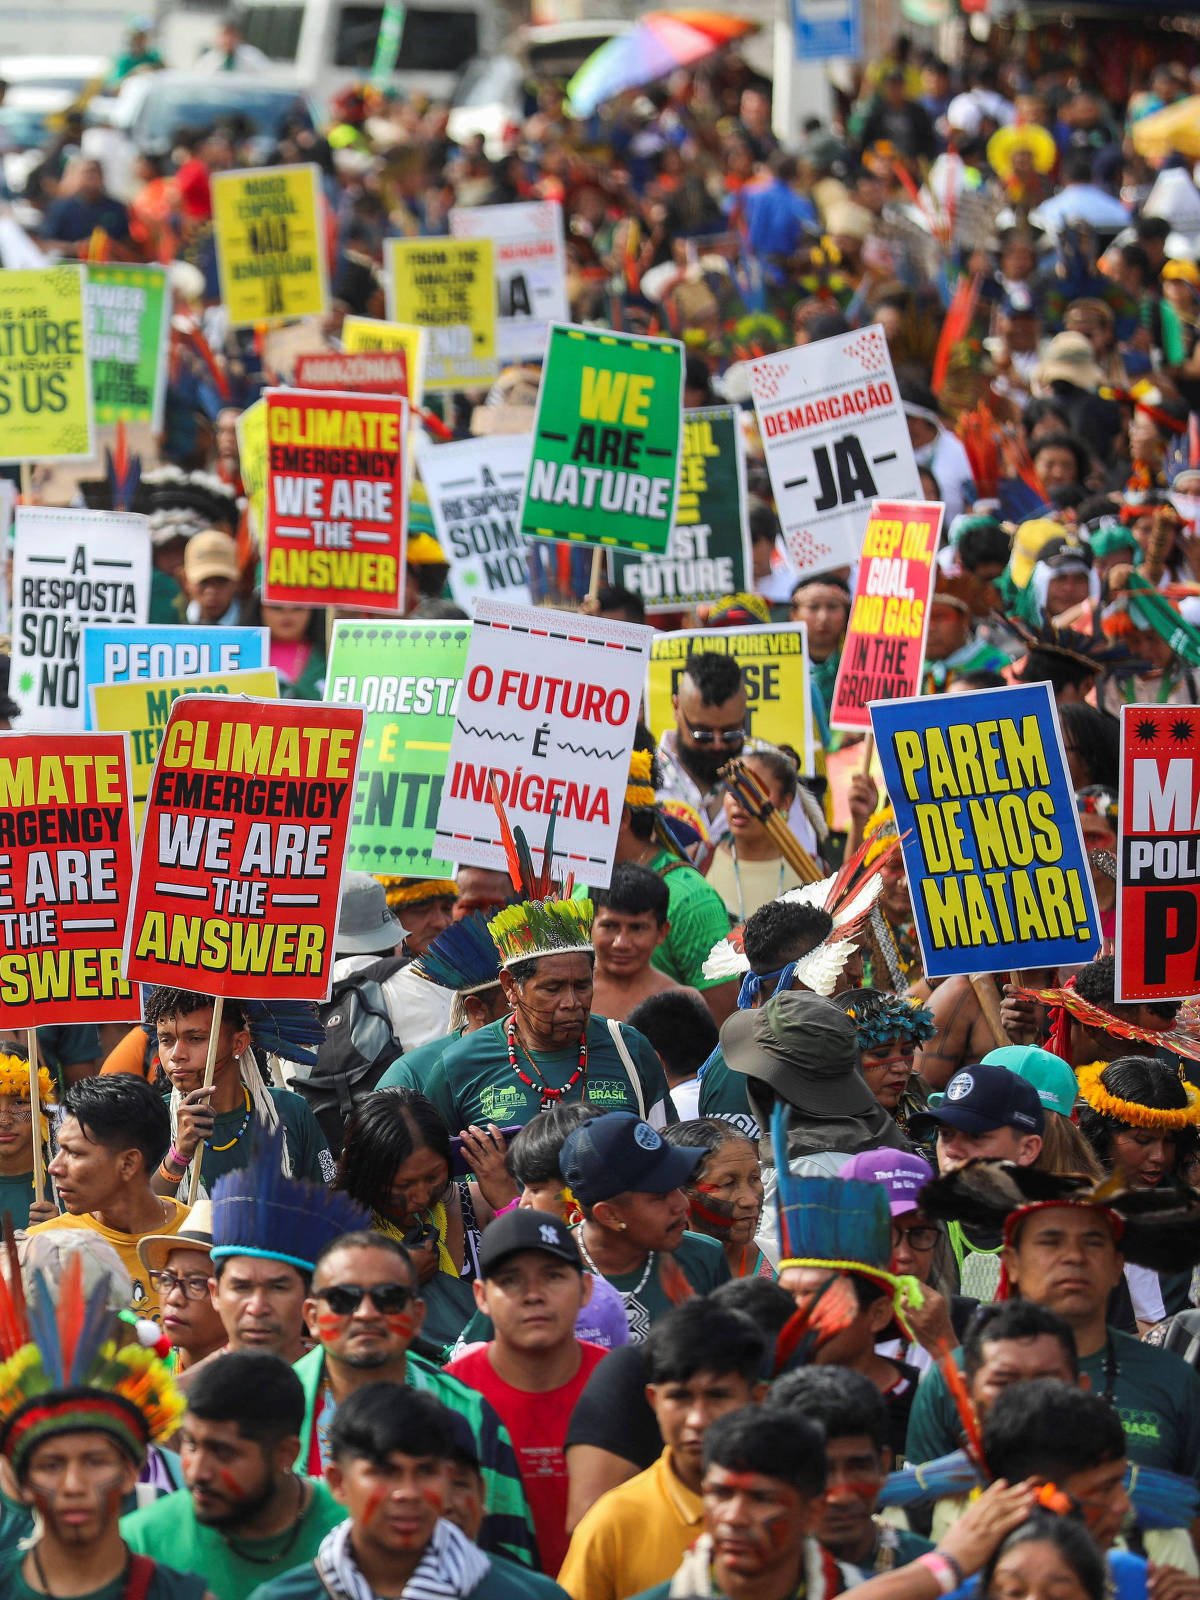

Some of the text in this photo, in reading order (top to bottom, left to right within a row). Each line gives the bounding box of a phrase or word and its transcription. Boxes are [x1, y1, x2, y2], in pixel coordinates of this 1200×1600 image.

[22, 373, 68, 415] US
[579, 366, 655, 428] WE
[764, 379, 894, 438] DEMARCAÇÃO
[269, 406, 400, 452] CLIMATE
[571, 422, 644, 470] ARE
[269, 447, 399, 478] EMERGENCY
[481, 464, 496, 488] A
[812, 431, 879, 512] JÁ
[273, 475, 394, 523] WE ARE
[529, 458, 671, 520] NATURE
[310, 520, 355, 549] THE
[861, 519, 933, 568] KEEP OIL,
[71, 545, 87, 575] A
[267, 547, 398, 594] ANSWER
[623, 556, 735, 597] FUTURE
[866, 557, 916, 603] COAL,
[21, 578, 137, 615] RESPOSTA
[849, 594, 925, 638] AND GAS
[728, 632, 802, 656] FOREVER
[851, 635, 909, 676] IN THE
[467, 664, 494, 703] O
[497, 668, 631, 727] FUTURO
[163, 720, 355, 779] CLIMATE
[377, 721, 400, 764] É
[531, 722, 551, 759] É
[892, 714, 1052, 802] PAREM
[154, 771, 349, 819] EMERGENCY
[449, 760, 611, 826] INDÍGENA
[158, 812, 333, 880] WE ARE
[914, 790, 1064, 876] DE NOS
[25, 848, 120, 907] ARE
[210, 876, 268, 918] THE
[921, 865, 1092, 950] MATAR!
[135, 909, 326, 977] ANSWER
[873, 1171, 894, 1180] The
